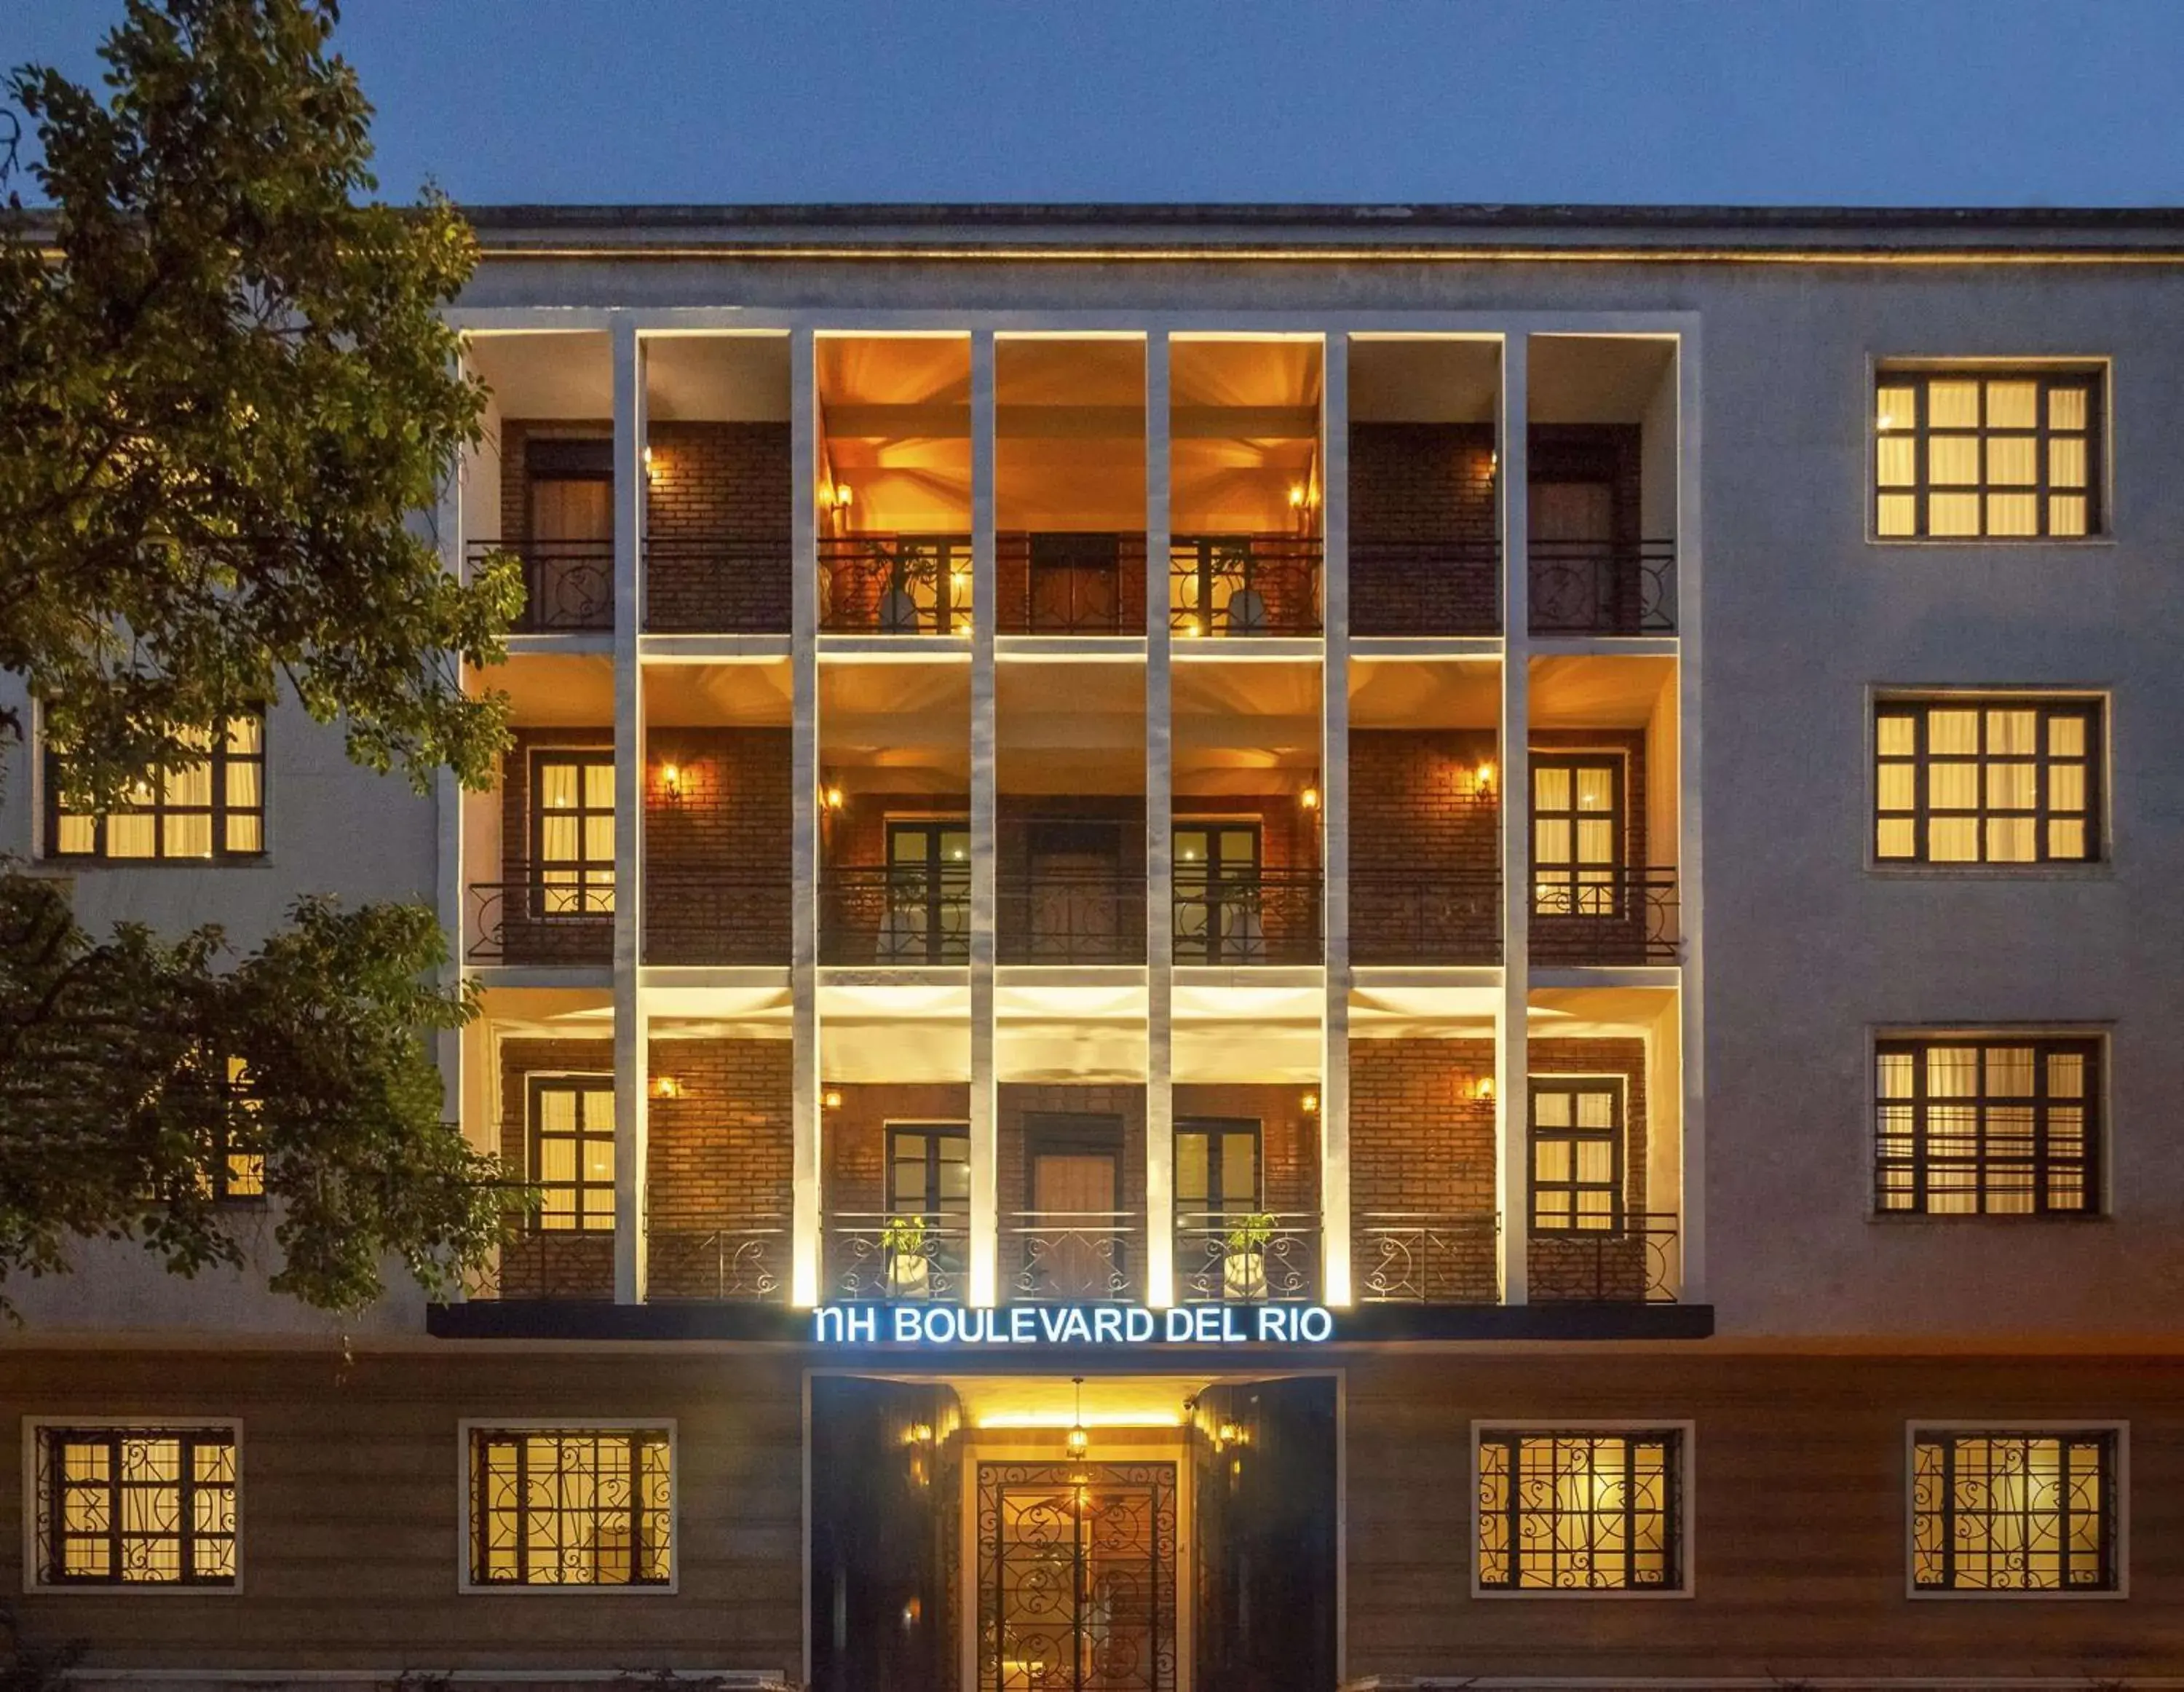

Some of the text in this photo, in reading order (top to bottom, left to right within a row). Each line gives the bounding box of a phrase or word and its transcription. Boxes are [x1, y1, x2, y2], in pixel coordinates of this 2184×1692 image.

[894, 1307, 1155, 1343] BOULEVARD
[1166, 1307, 1247, 1343] DEL
[1258, 1307, 1332, 1343] RIO
